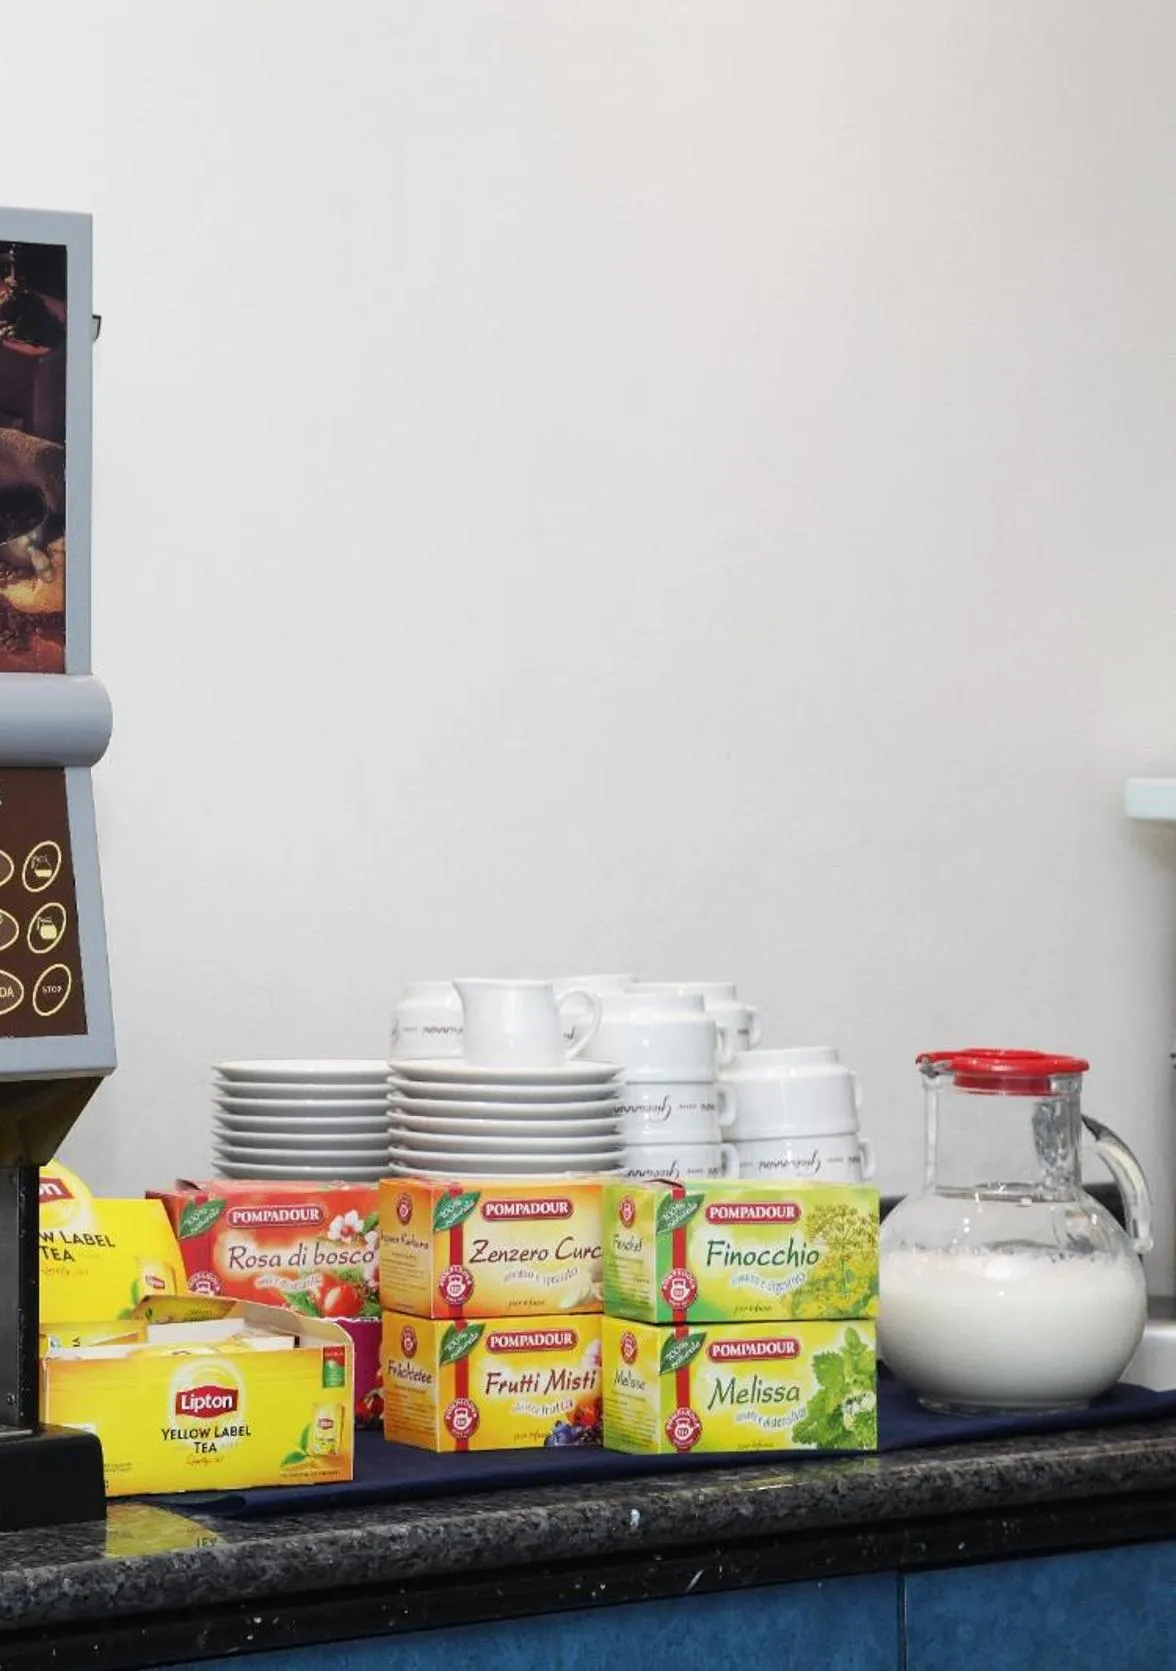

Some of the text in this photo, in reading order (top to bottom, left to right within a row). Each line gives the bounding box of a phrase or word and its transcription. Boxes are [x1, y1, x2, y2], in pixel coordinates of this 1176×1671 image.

[41, 986, 63, 994] STOP
[232, 1206, 321, 1225] POMPADOUR
[485, 1202, 569, 1218] POMPADOUR
[709, 1205, 796, 1220] POMPADOUR
[60, 1230, 116, 1248] LABEL
[39, 1245, 76, 1262] TEA
[228, 1241, 374, 1269] Rosa di bosco
[469, 1236, 602, 1263] Zenzero Curc
[706, 1238, 820, 1267] Finocchio
[490, 1332, 574, 1349] POMPADOUR
[711, 1344, 796, 1358] POMPADOUR
[485, 1368, 597, 1395] Frutti Misti
[707, 1374, 800, 1410] Melissa
[181, 1393, 233, 1413] Lipton
[162, 1424, 252, 1441] YELLOW LABEL
[194, 1441, 217, 1454] TEA
